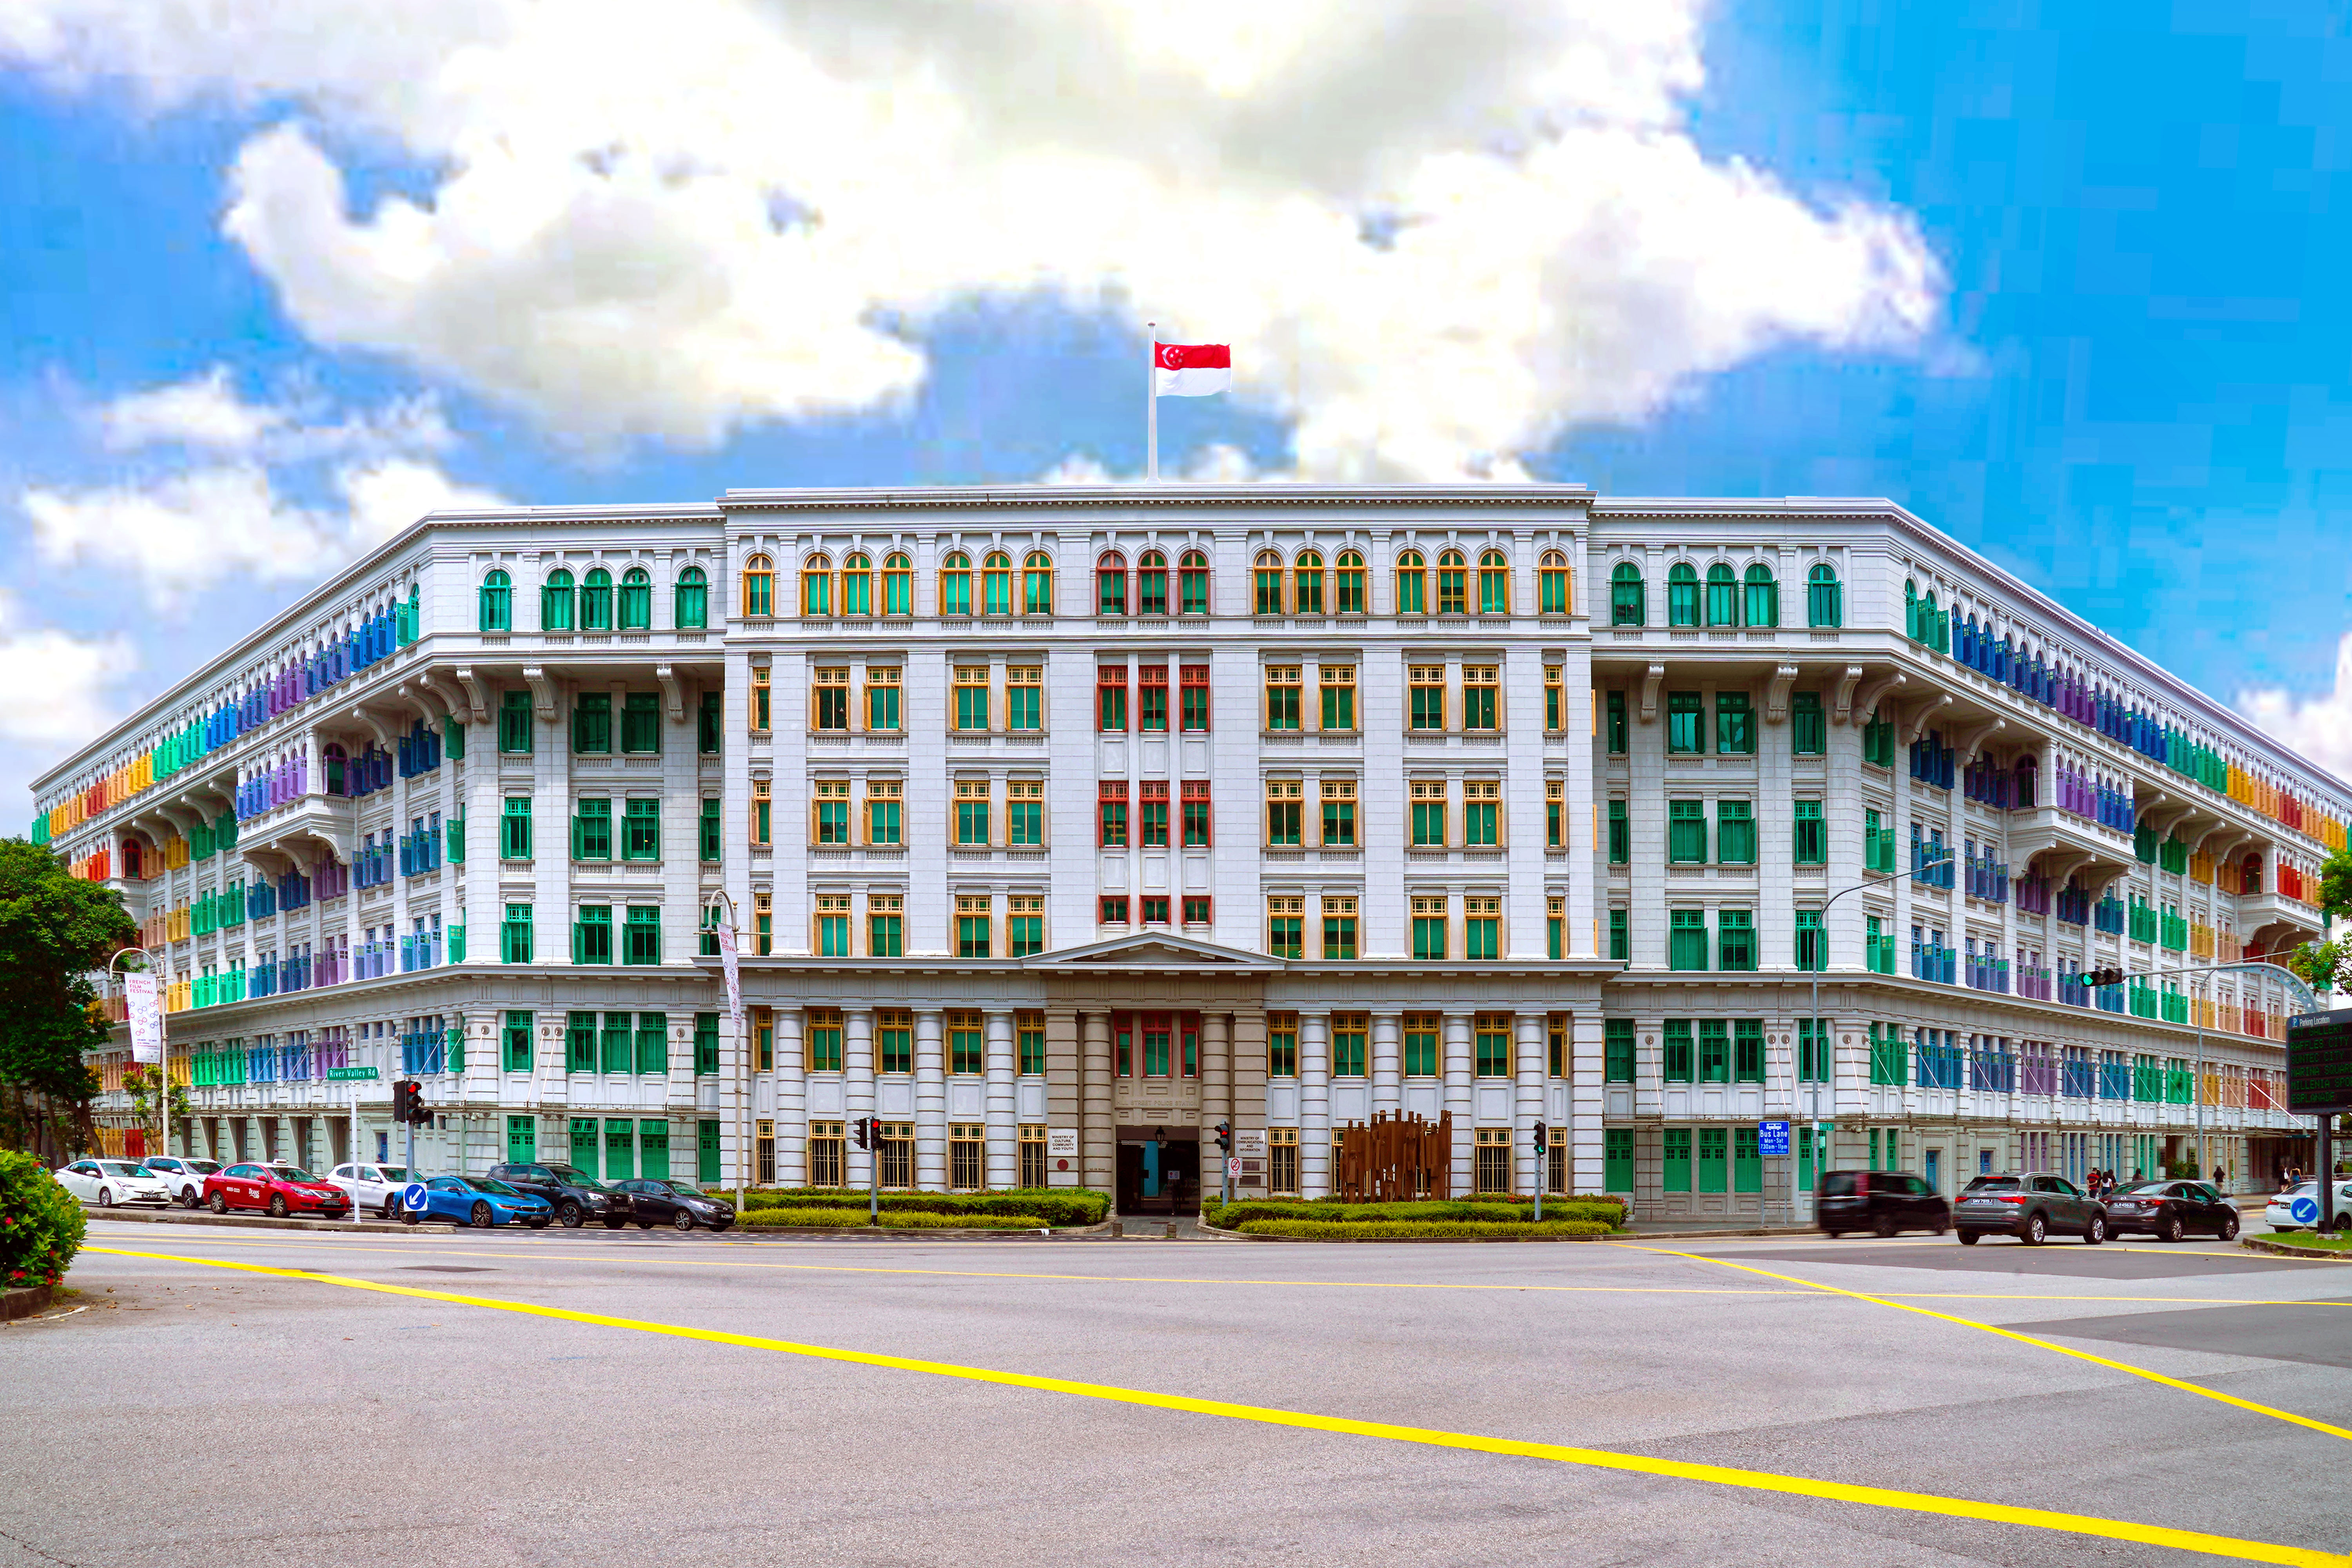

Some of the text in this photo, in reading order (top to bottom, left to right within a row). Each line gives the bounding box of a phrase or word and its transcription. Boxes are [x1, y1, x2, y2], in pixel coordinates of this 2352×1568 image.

[2299, 1018, 2313, 1027] Parking
[2314, 1016, 2330, 1025] Location
[2309, 1023, 2343, 1036] GALLERY
[2290, 1036, 2348, 1051] RAFFLES CITY
[2291, 1050, 2344, 1065] SUNTEC CITY
[347, 1069, 365, 1078] Valley
[2291, 1066, 2320, 1077] MARINA
[2291, 1079, 2330, 1090] MILLENIA
